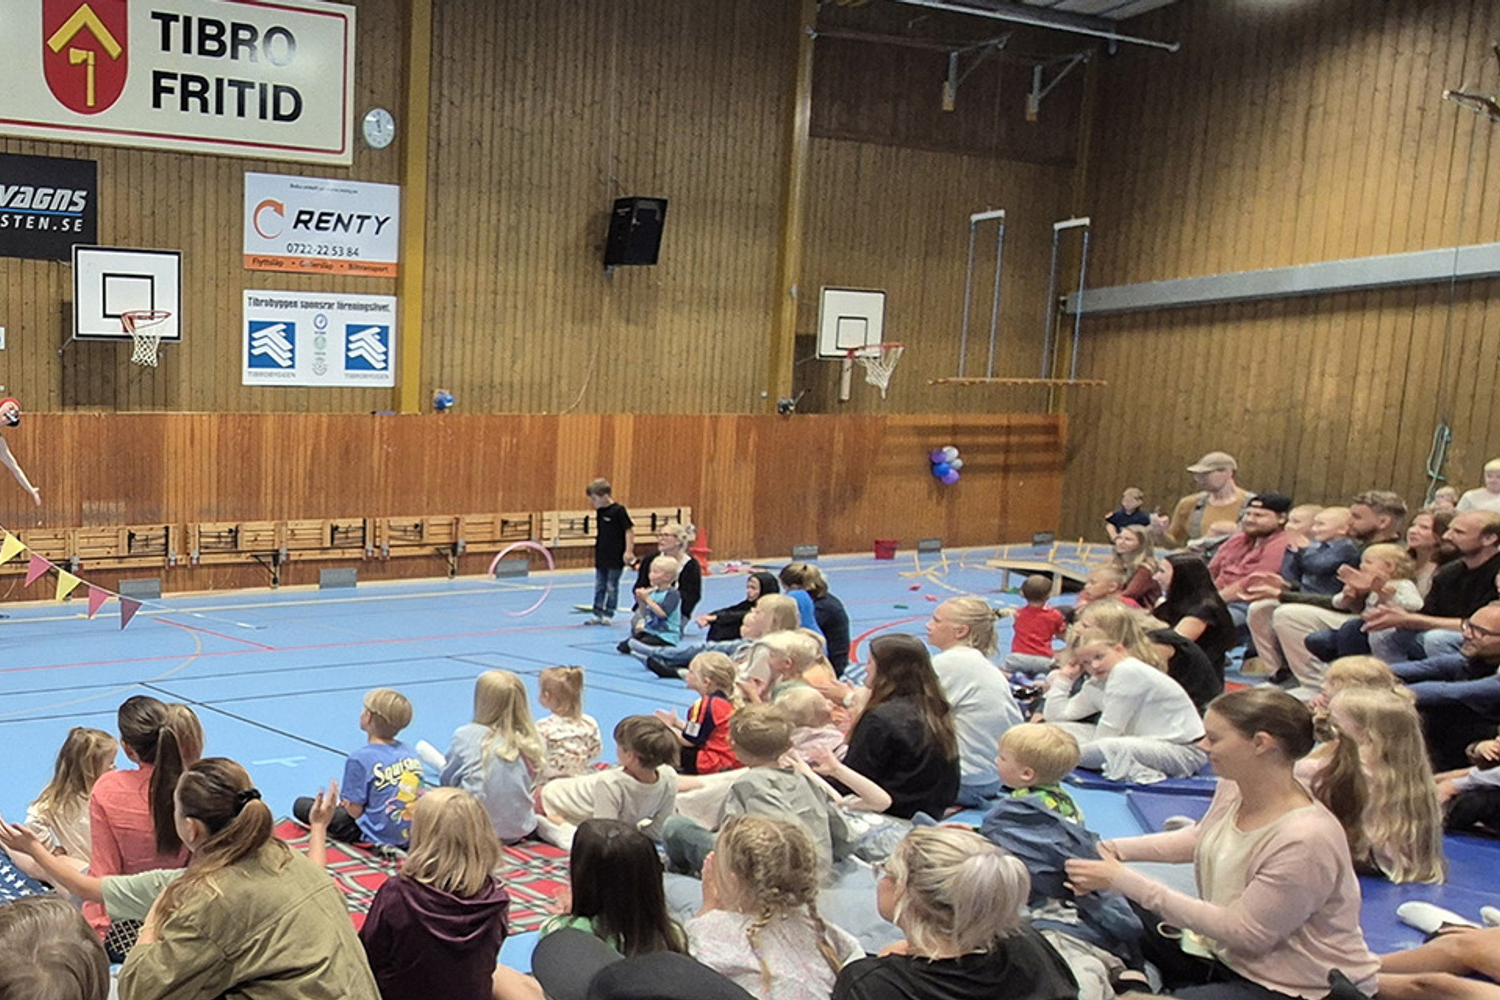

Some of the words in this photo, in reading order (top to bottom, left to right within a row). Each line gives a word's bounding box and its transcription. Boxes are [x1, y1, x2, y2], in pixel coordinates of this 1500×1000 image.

[151, 11, 297, 67] TIBRO
[151, 70, 303, 122] FRITID
[292, 210, 391, 235] RENTY
[286, 243, 328, 255] 0722-22
[332, 245, 344, 256] 53
